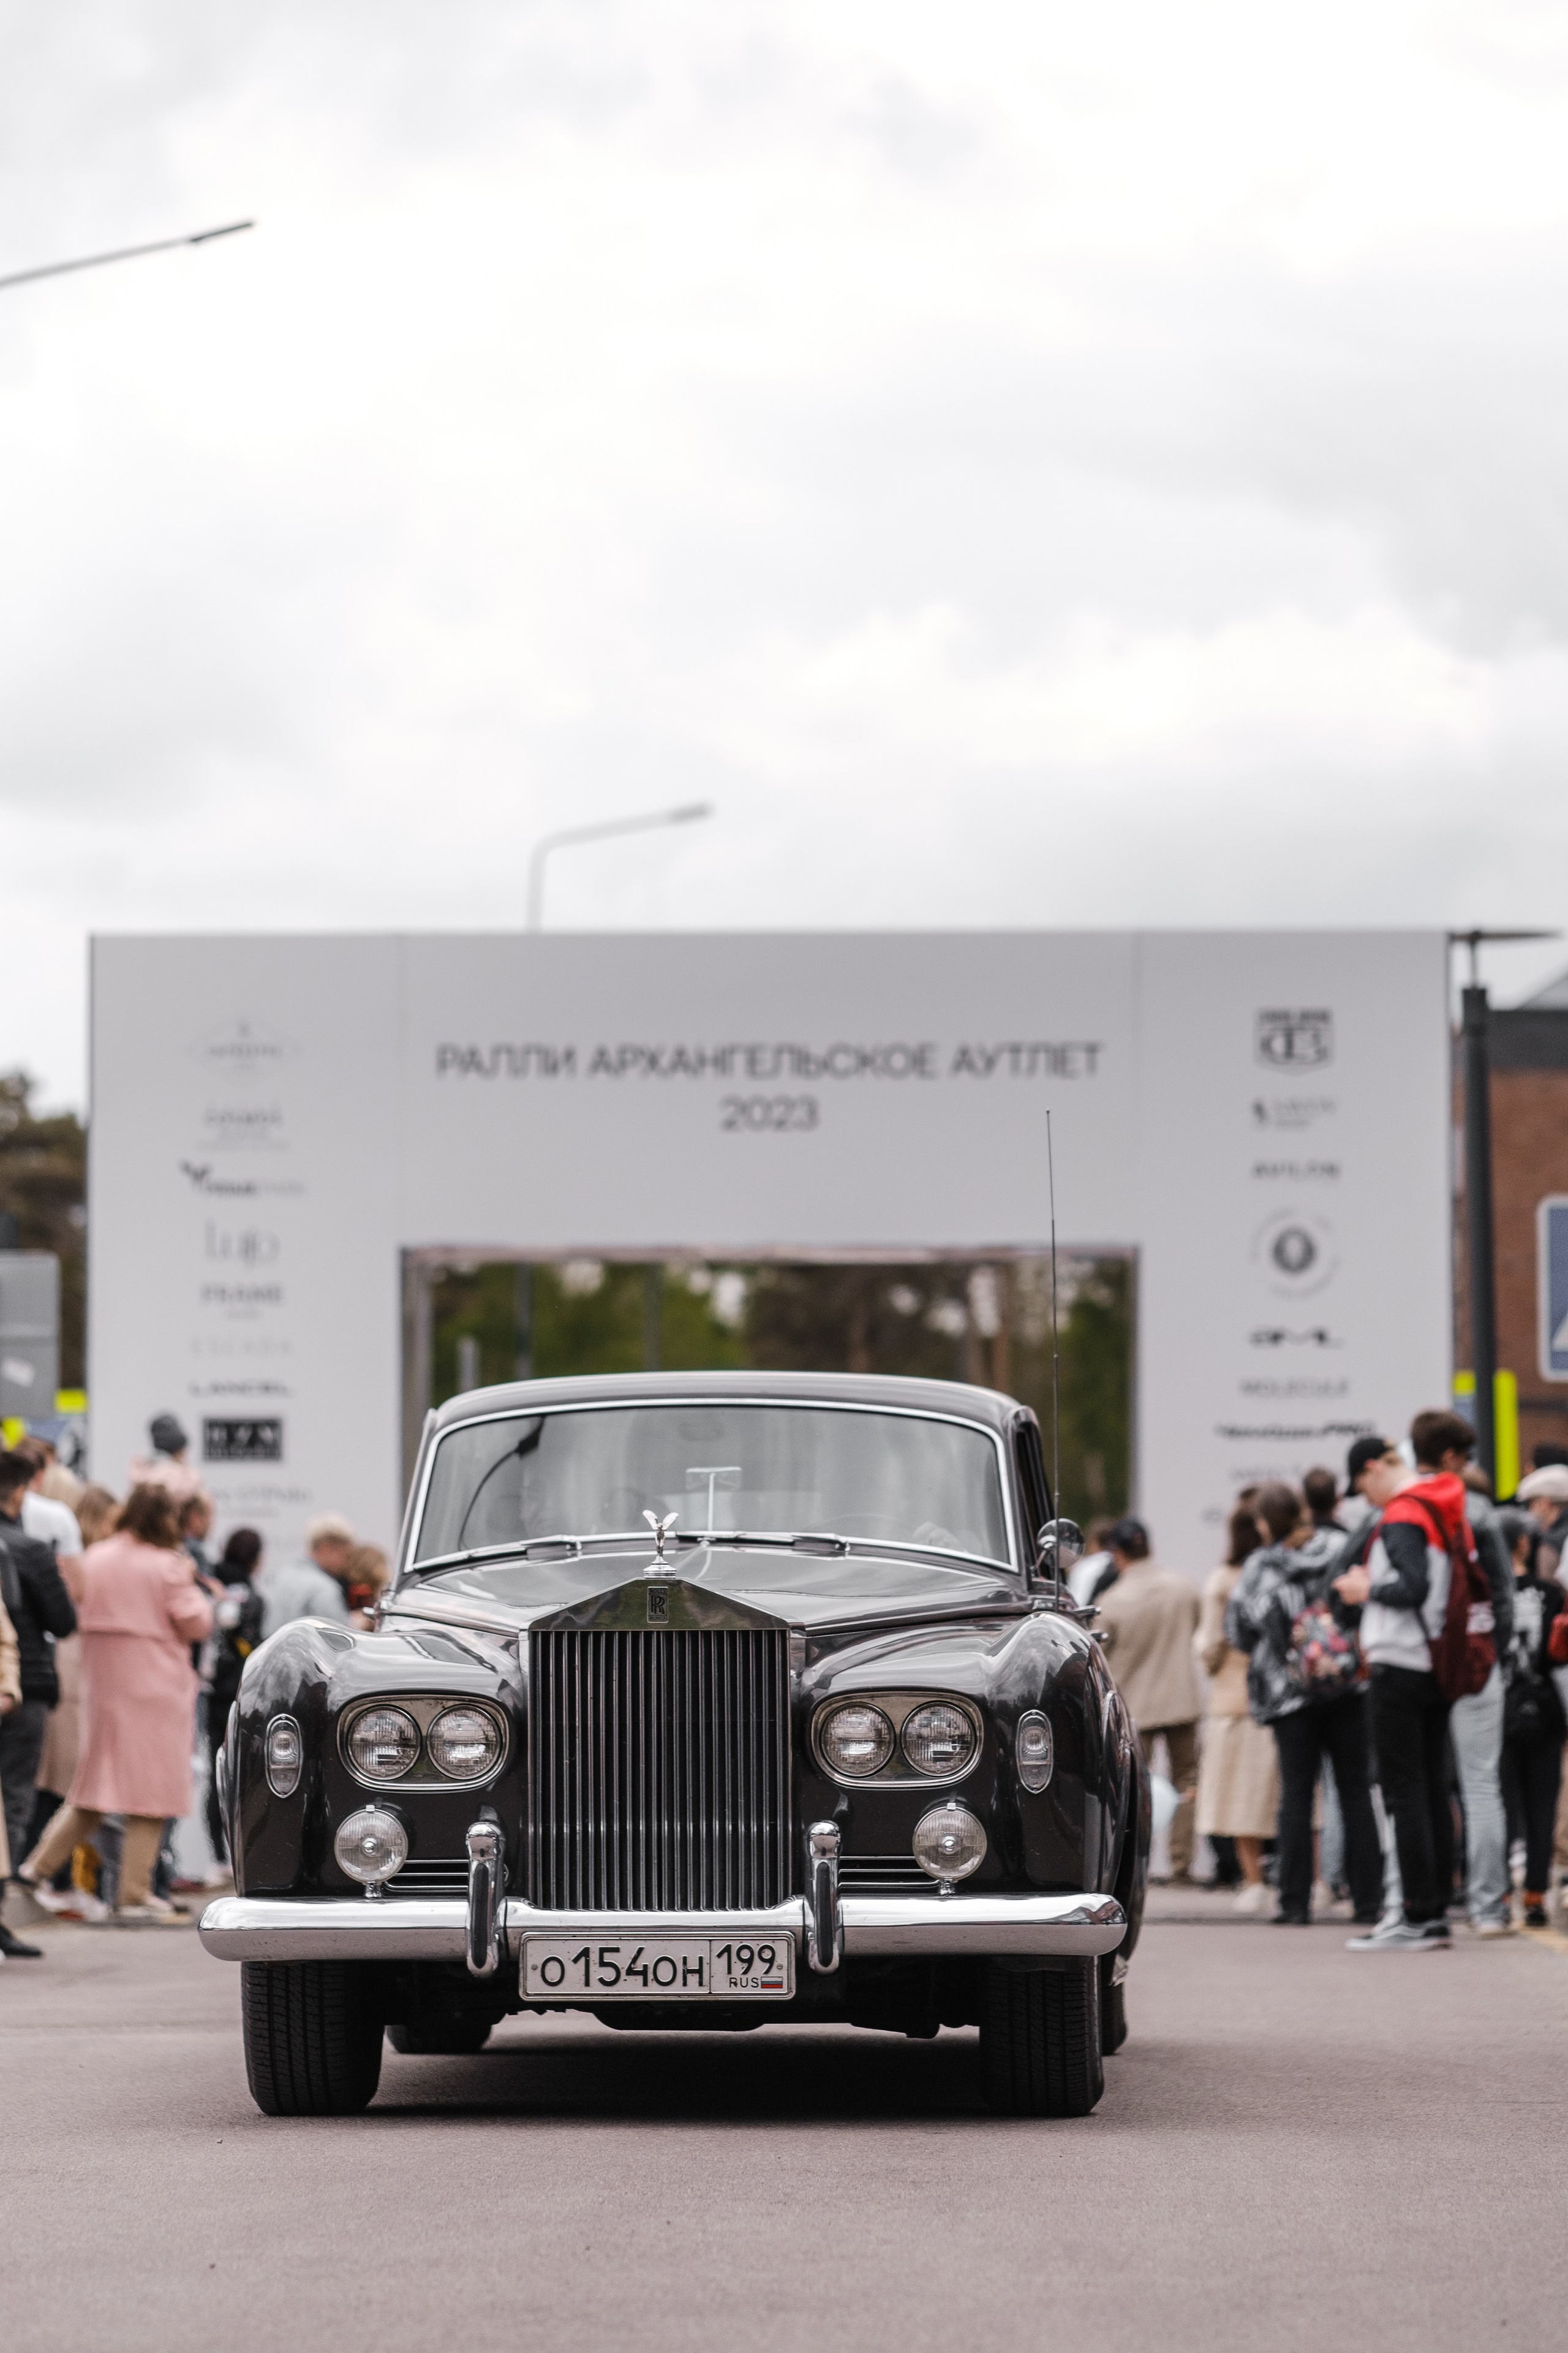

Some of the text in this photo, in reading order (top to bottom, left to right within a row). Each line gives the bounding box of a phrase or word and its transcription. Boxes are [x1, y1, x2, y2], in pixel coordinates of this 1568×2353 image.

[436, 1043, 1103, 1080] РАЛЛИ АРХАНГЕЛЬСКОЕ АУТЛЕТ
[720, 1095, 820, 1133] 2023
[716, 1943, 776, 1976] 199
[728, 1977, 760, 1989] RUS
